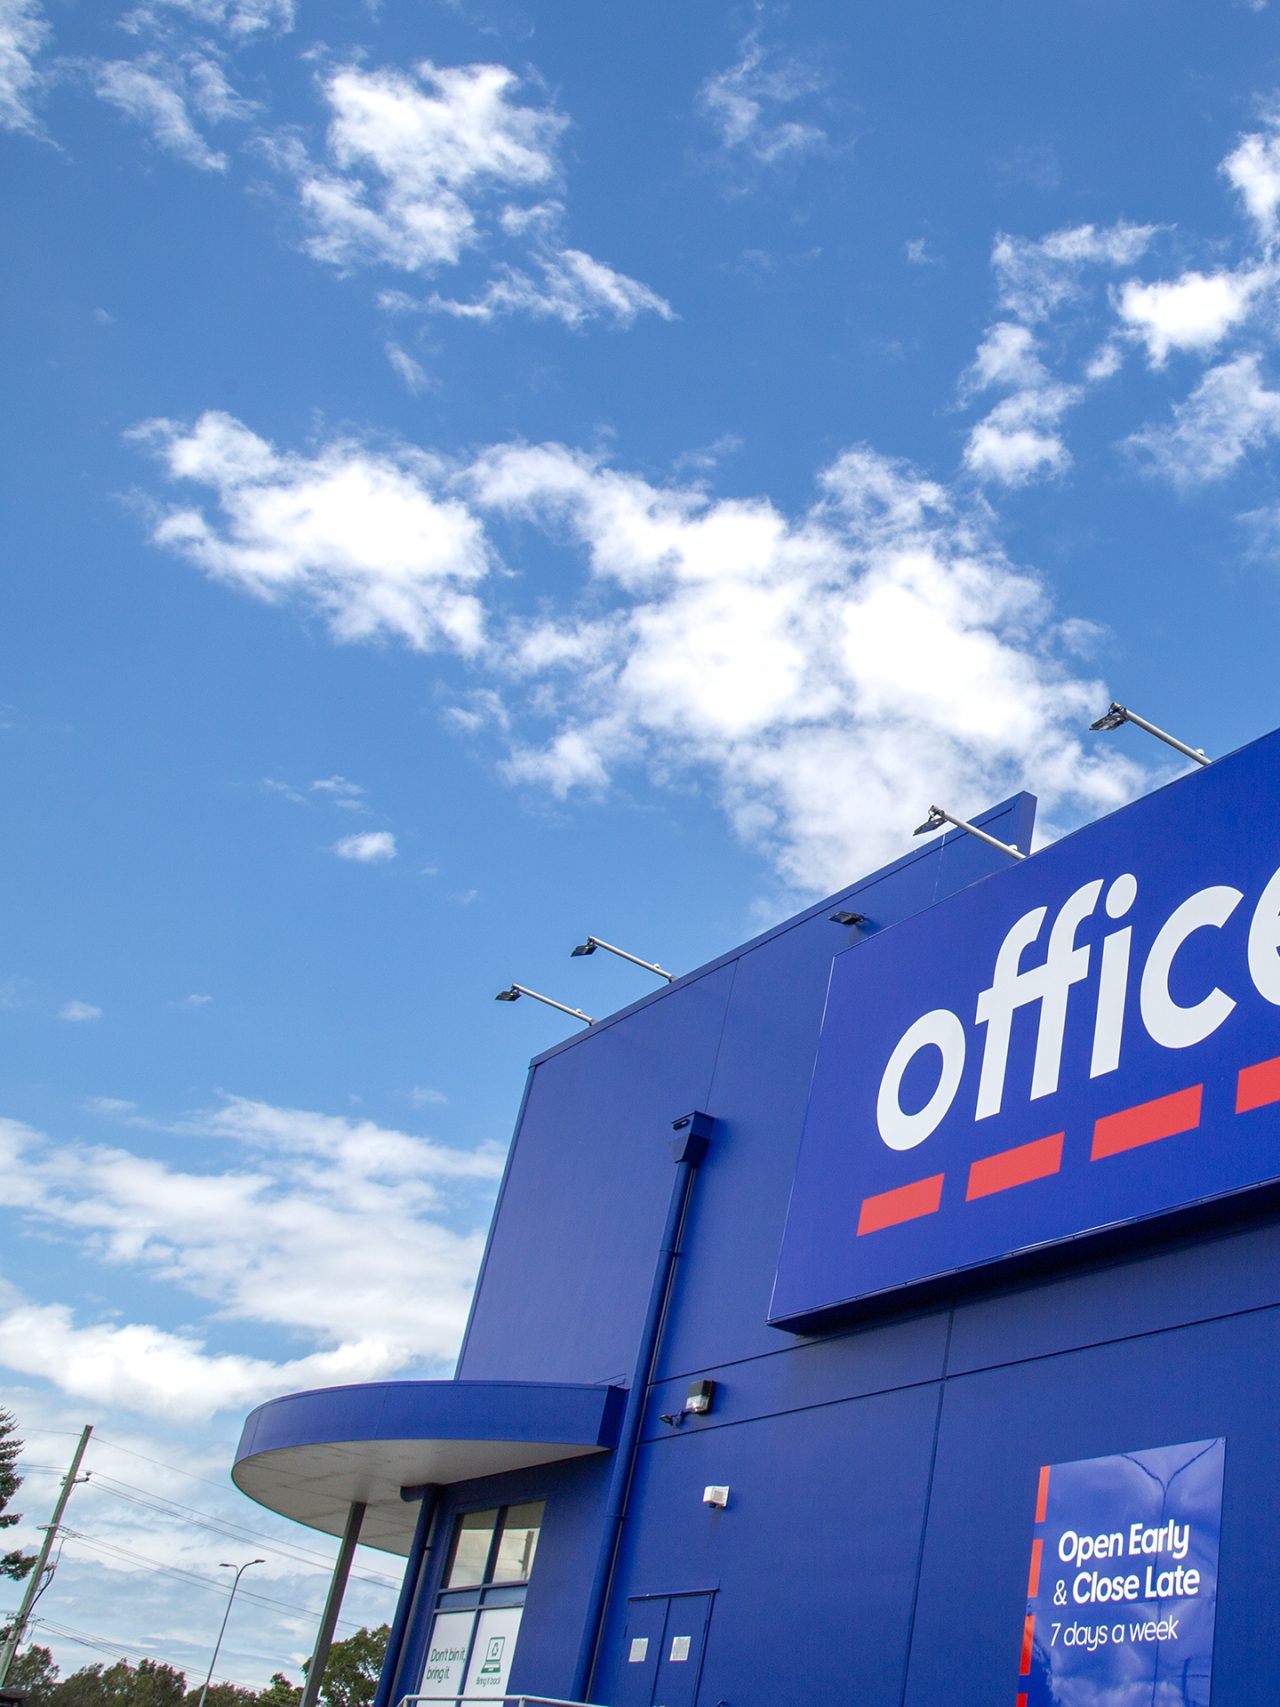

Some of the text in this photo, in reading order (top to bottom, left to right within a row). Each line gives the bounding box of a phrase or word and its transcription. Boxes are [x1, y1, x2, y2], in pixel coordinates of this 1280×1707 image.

[1058, 1519, 1190, 1568] Open Early
[1053, 1565, 1200, 1606] & Close Late
[1050, 1615, 1179, 1651] 7 days a week
[430, 1648, 448, 1662] Don't
[448, 1647, 459, 1661] bin
[426, 1666, 444, 1683] bring
